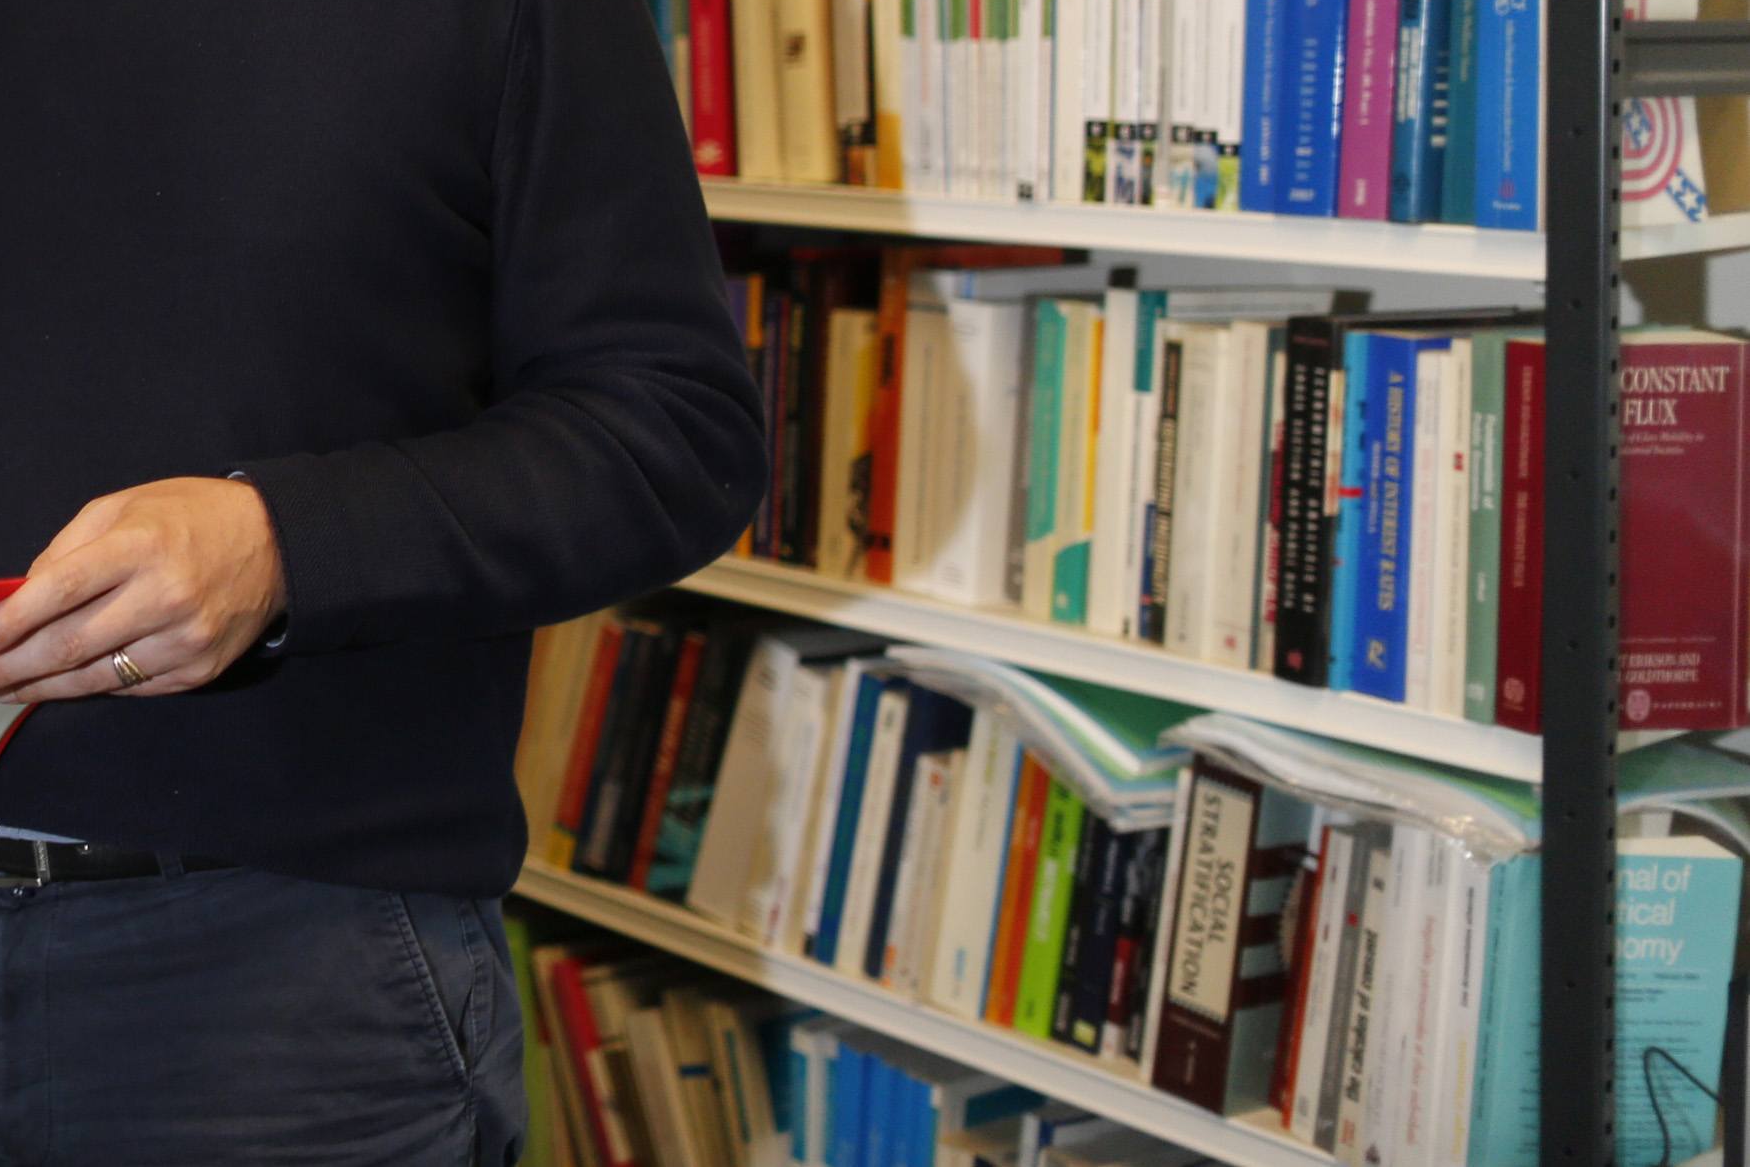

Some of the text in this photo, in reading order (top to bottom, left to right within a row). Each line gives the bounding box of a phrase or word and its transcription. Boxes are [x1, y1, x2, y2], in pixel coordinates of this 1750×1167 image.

[1620, 366, 1729, 392] CONSTANT
[1622, 398, 1678, 425] FLUX
[1377, 372, 1404, 611] A HISTORY OF INTEREST RATES
[1179, 791, 1222, 997] STRATIFICATION
[1207, 858, 1235, 943] SOCIAL
[1617, 863, 1691, 893] nal of
